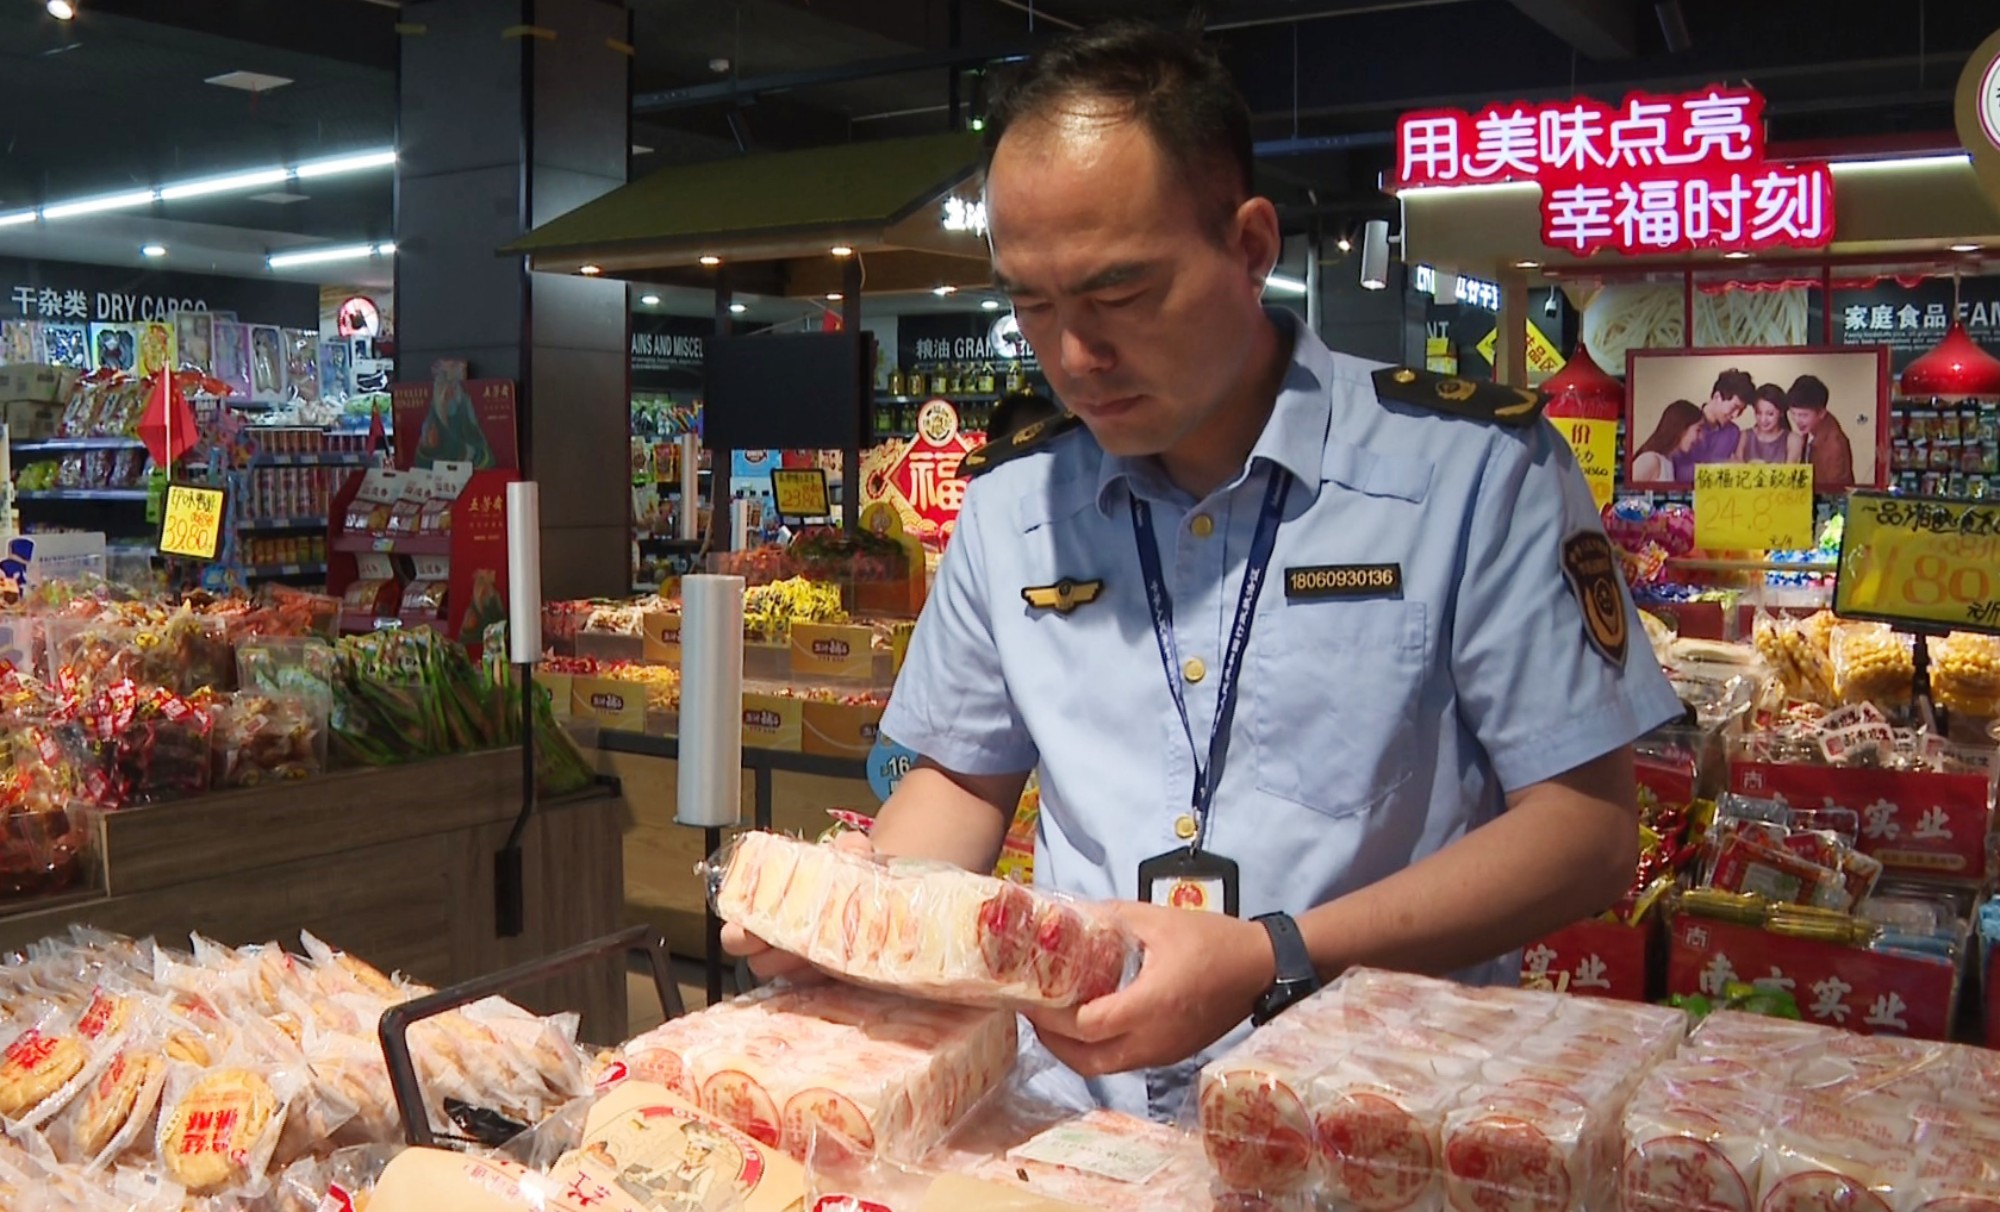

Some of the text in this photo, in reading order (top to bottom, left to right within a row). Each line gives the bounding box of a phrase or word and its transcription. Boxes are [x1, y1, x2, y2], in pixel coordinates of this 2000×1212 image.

[1402, 92, 1753, 182] 用美味点亮
[1547, 169, 1822, 248] 幸福时刻
[12, 286, 88, 318] 干杂类
[97, 292, 138, 322] DRY
[1844, 303, 1947, 331] 家庭食品
[654, 334, 672, 356] AND
[916, 338, 950, 359] 粮油
[909, 452, 968, 512] 福
[1290, 569, 1394, 590] 18060930136
[888, 755, 911, 777] 16
